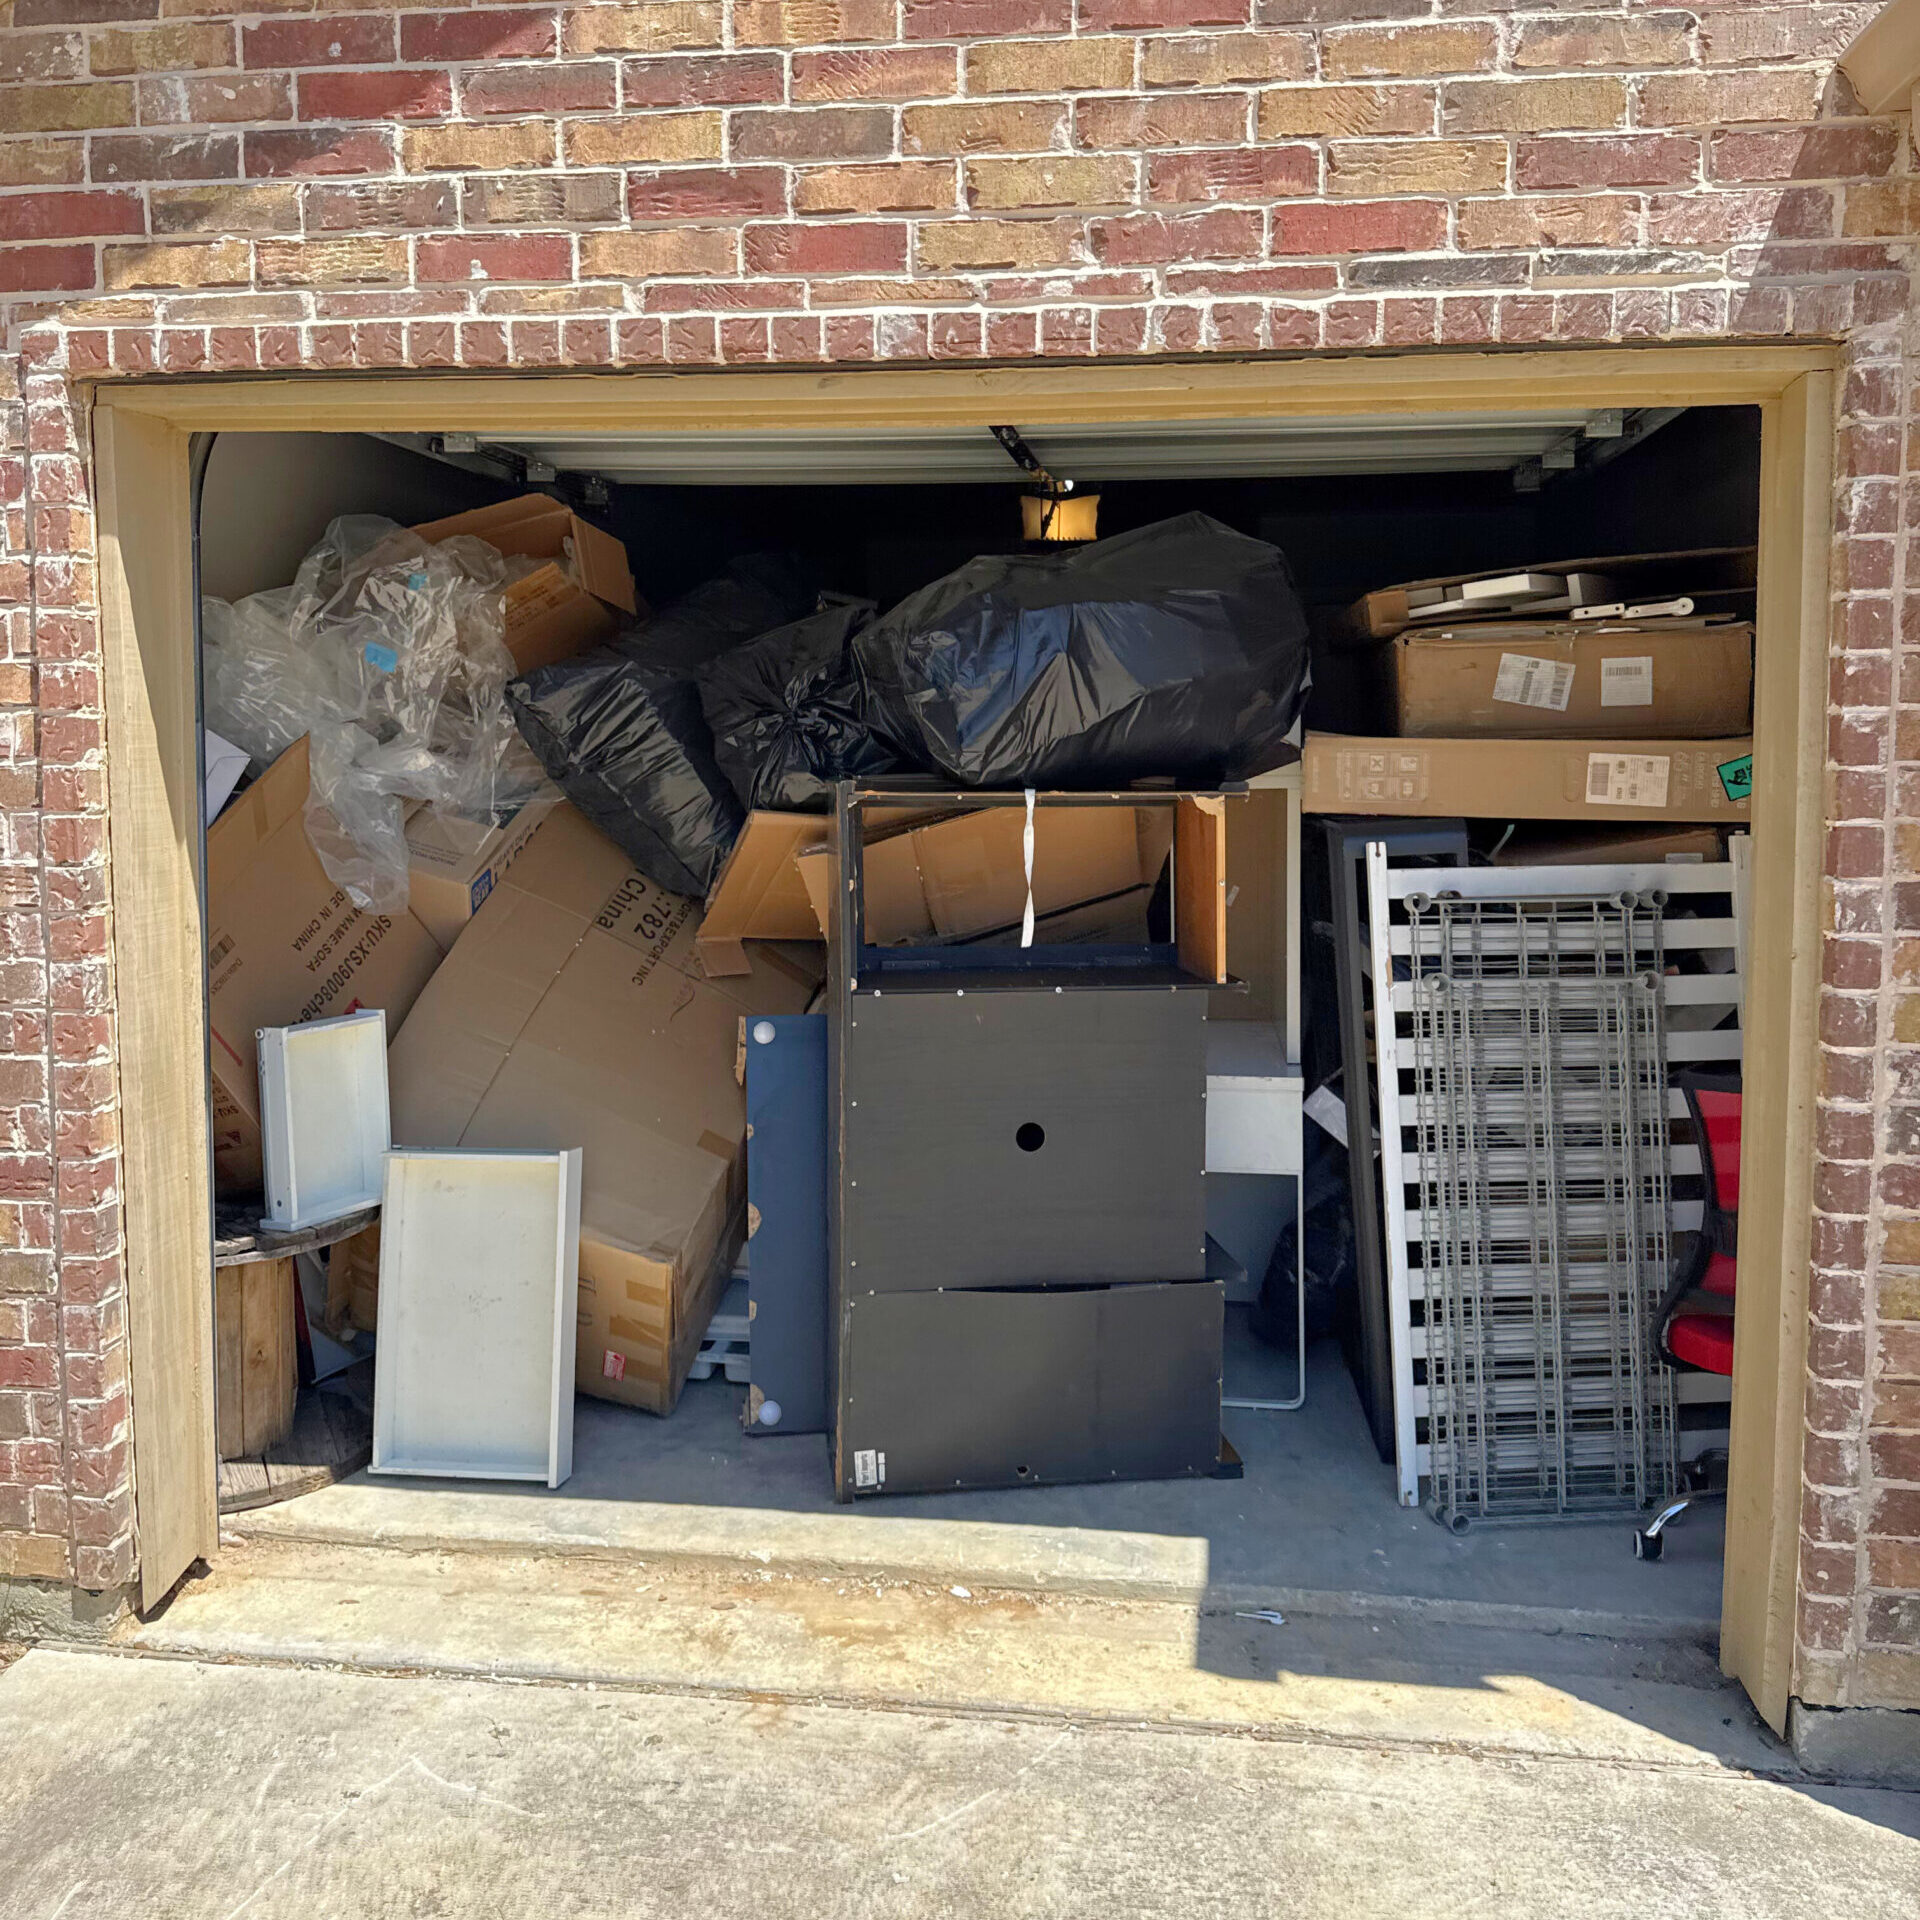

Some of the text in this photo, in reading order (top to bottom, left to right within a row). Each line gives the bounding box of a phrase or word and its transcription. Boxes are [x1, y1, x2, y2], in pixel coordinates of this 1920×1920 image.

[319, 906, 332, 920] IN
[596, 878, 647, 929] China
[292, 919, 321, 952] CHINA
[632, 965, 651, 986] INC
